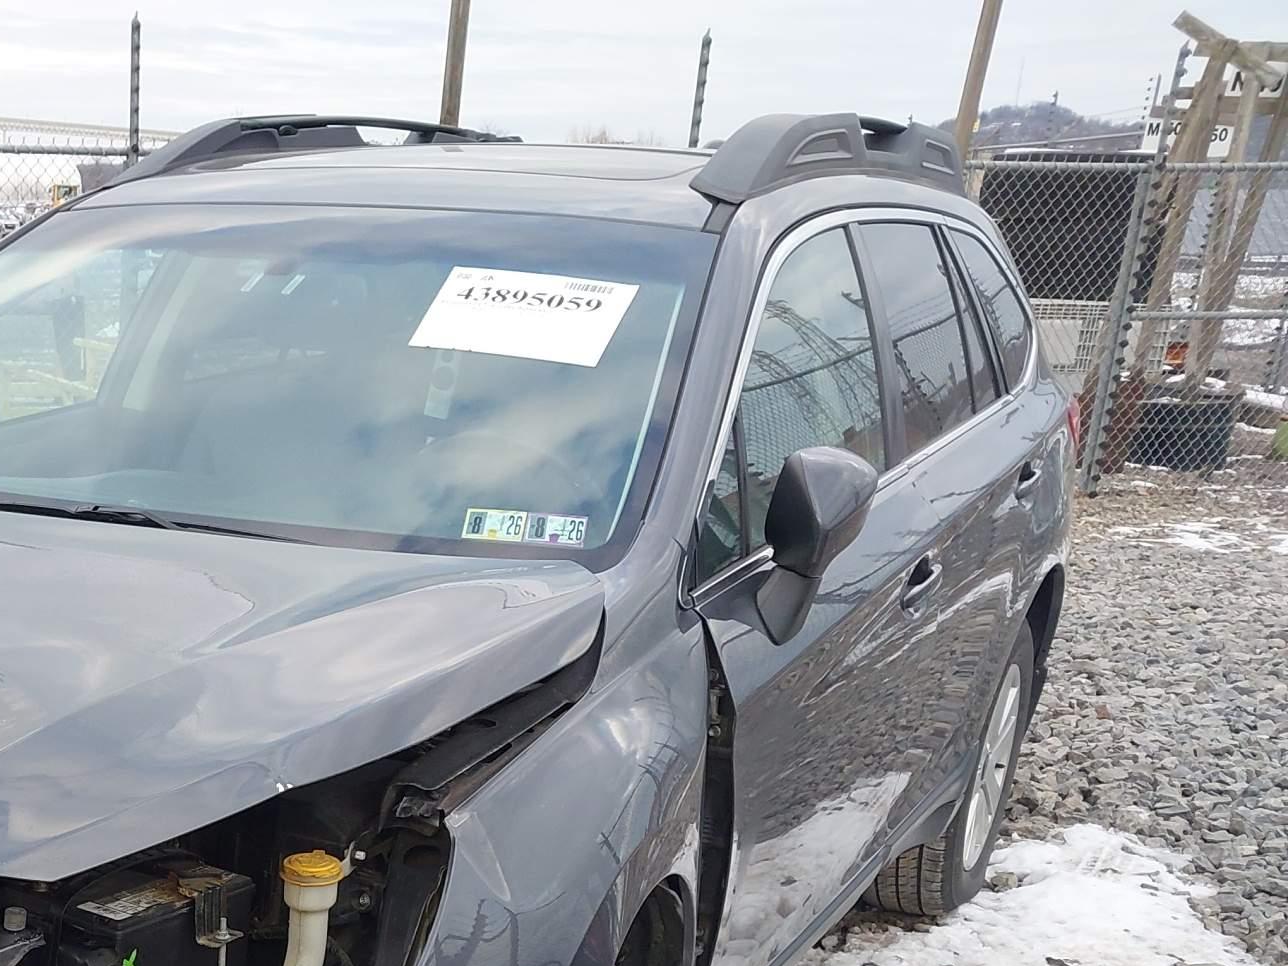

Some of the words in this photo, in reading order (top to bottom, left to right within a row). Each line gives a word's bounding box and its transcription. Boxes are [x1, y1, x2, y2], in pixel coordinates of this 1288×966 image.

[1147, 122, 1161, 136] M
[456, 286, 603, 313] 43895059
[471, 516, 483, 534] 8
[506, 515, 523, 536] 26
[534, 517, 546, 538] 8
[568, 519, 585, 541] 26
